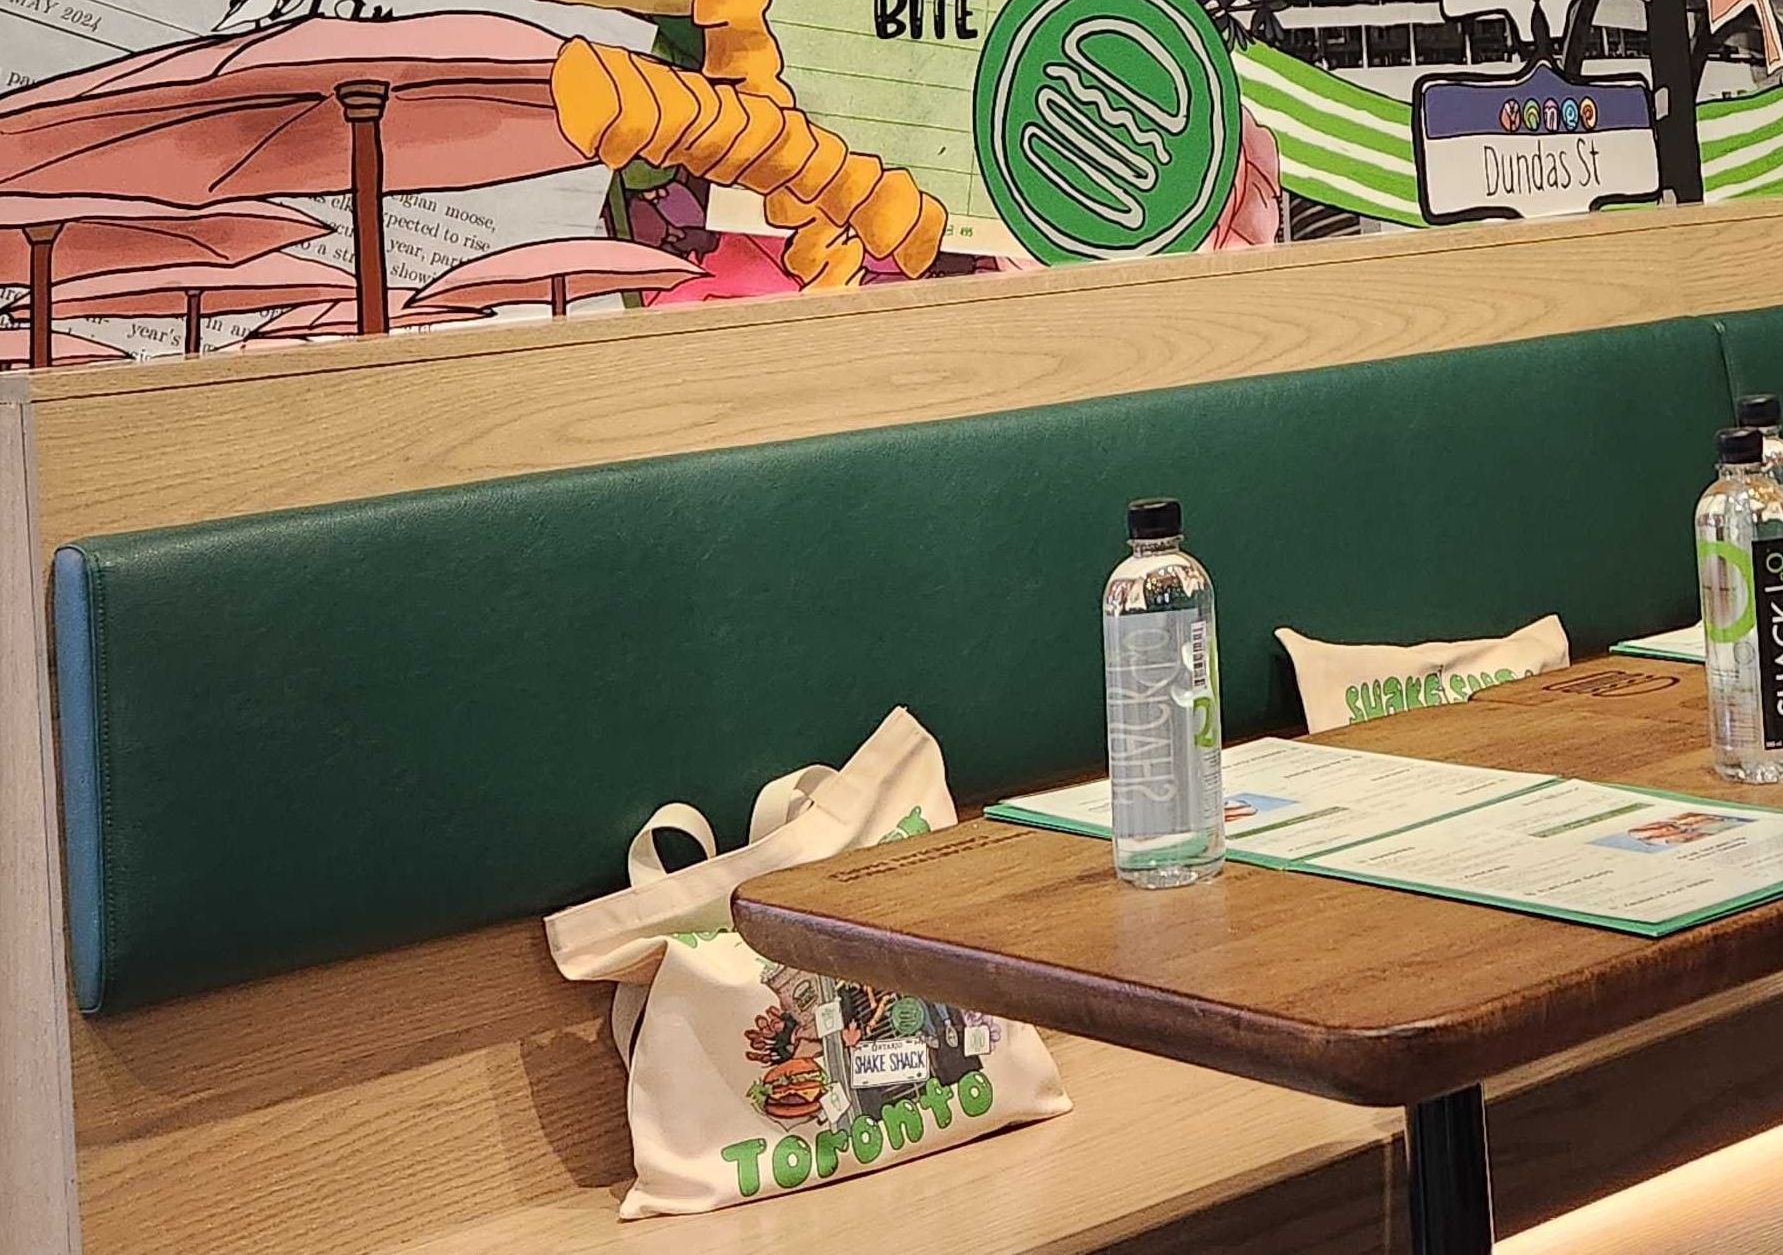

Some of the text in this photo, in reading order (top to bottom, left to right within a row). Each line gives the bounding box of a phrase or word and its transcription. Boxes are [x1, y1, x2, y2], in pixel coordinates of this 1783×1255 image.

[60, 6, 103, 33] 2024
[1482, 136, 1603, 199] Dundas St
[444, 204, 498, 234] moose,
[383, 212, 492, 254] pected to rise
[386, 237, 426, 262] year,
[126, 322, 183, 347] year's
[854, 1049, 927, 1075] SHAKE SHACK
